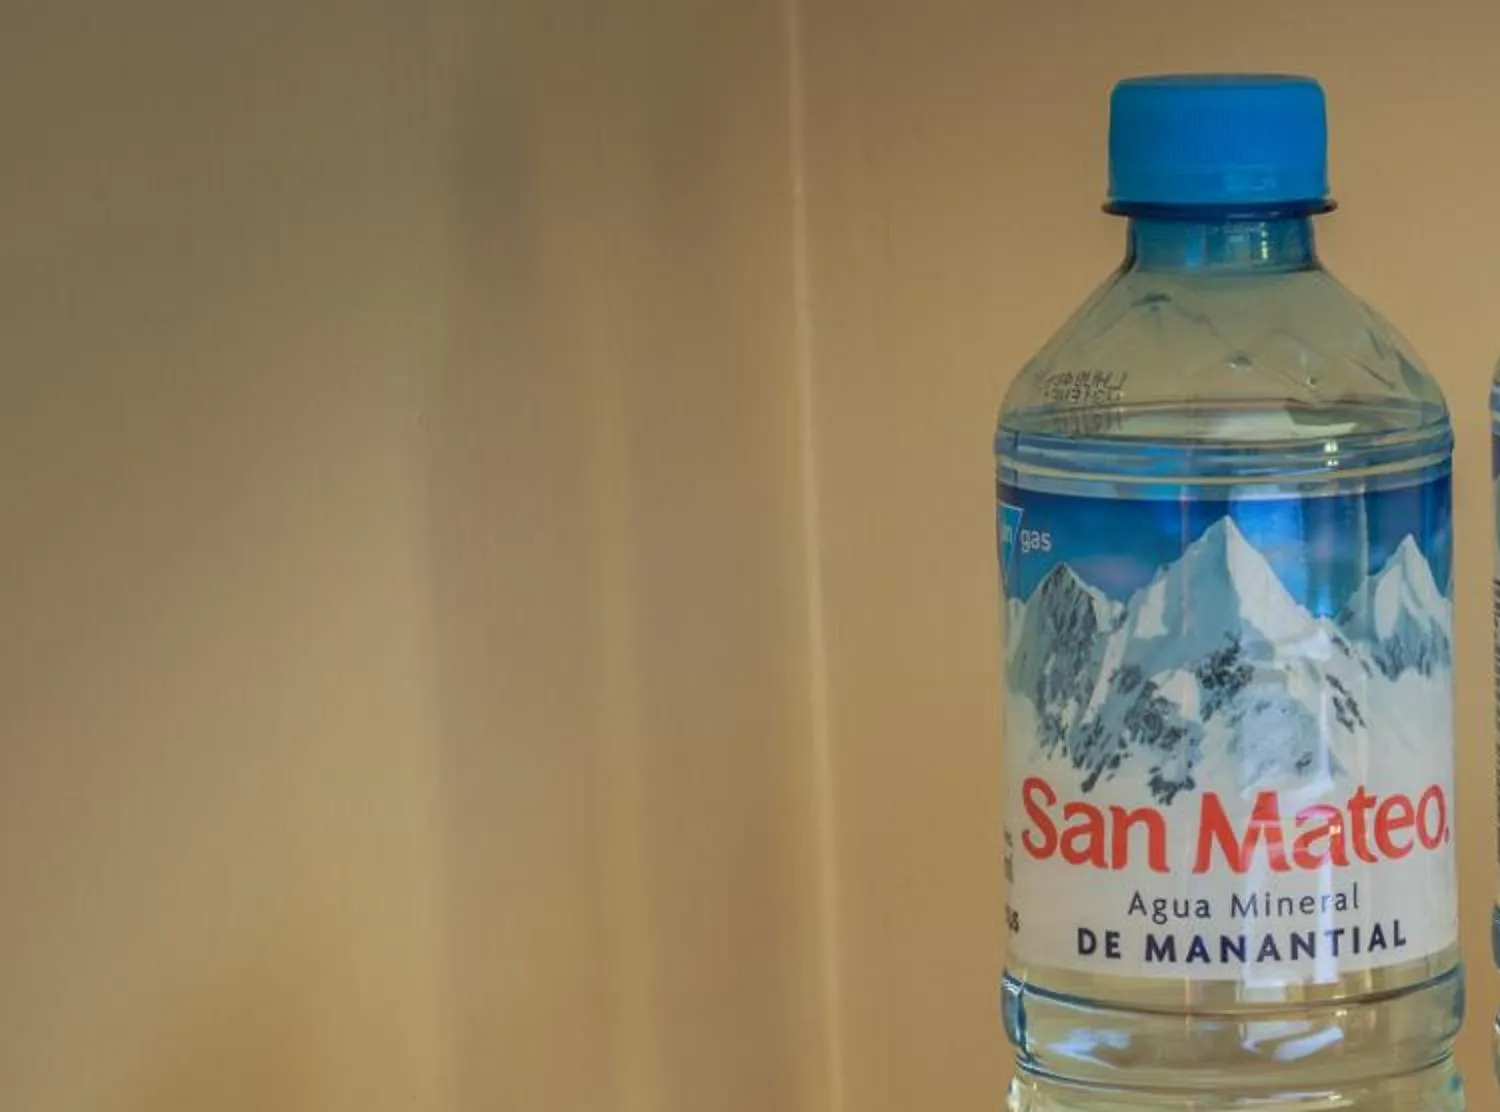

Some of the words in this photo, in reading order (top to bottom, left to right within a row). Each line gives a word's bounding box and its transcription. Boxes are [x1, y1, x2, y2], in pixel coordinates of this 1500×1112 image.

[1020, 529, 1052, 553] gas
[1021, 776, 1171, 873] San
[1191, 783, 1447, 874] Mateo
[1127, 890, 1210, 925] Agua
[1230, 882, 1361, 918] Mineral
[1077, 927, 1121, 959] DE
[1145, 919, 1407, 964] MANANTIAL
